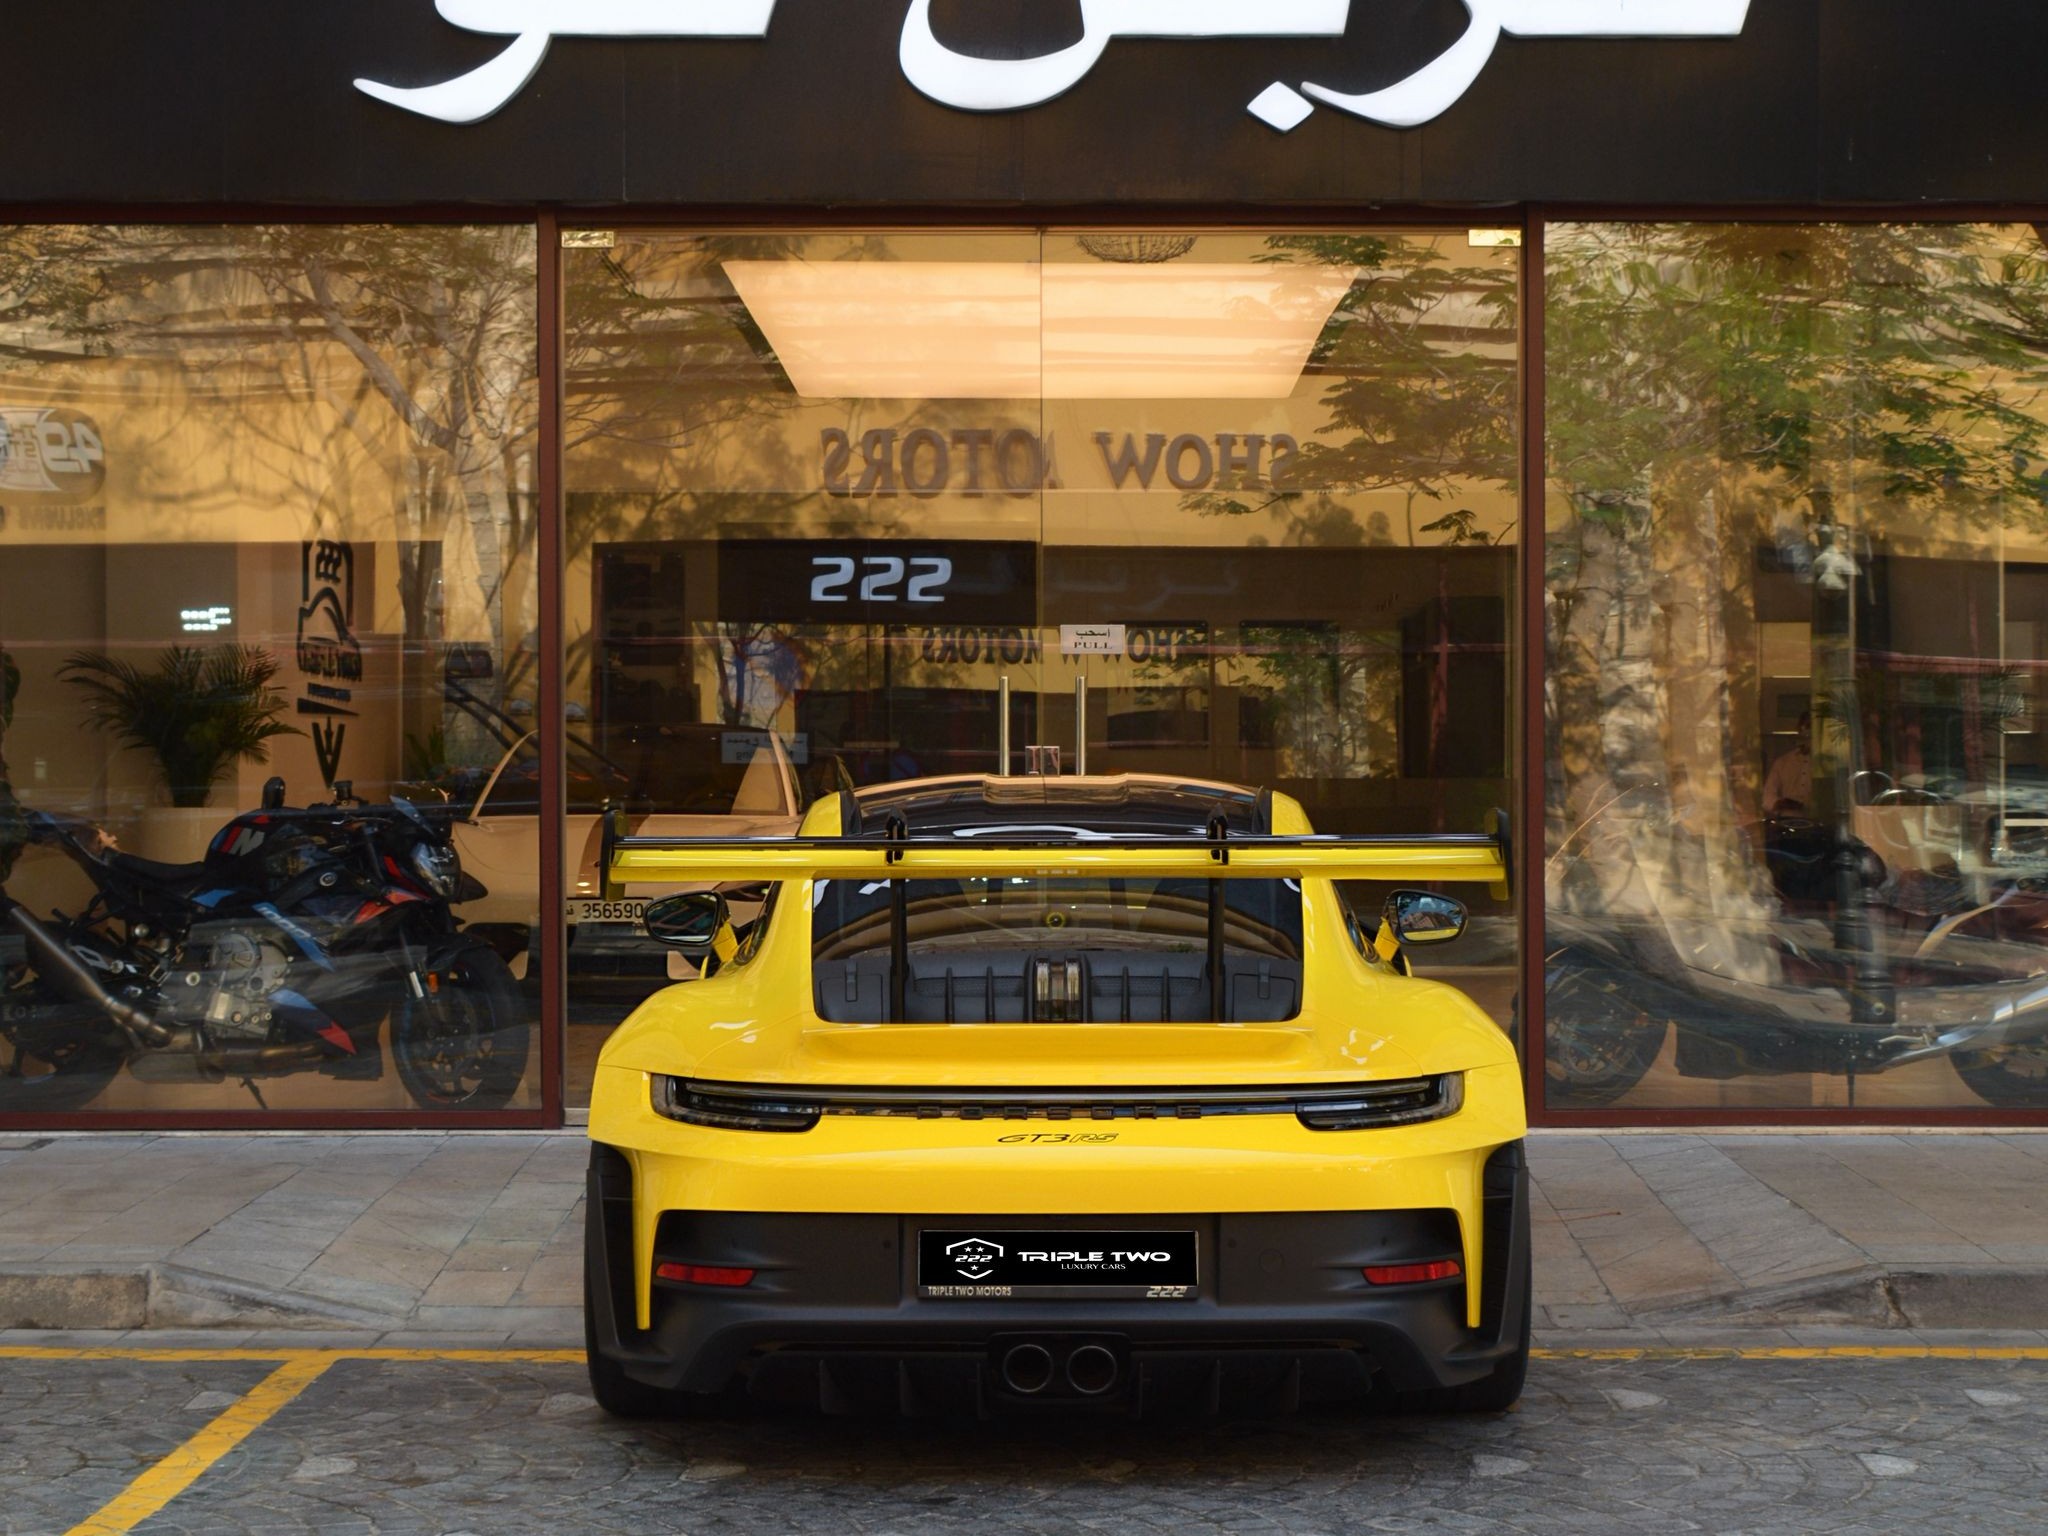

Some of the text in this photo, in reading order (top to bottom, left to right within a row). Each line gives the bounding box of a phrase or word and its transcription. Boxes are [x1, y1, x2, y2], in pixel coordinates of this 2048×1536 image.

[810, 556, 953, 603] 222
[1074, 641, 1113, 650] PULL
[581, 902, 645, 919] 356590
[954, 1253, 994, 1263] 222
[1017, 1251, 1172, 1263] TRIPLE TWO
[1061, 1263, 1127, 1271] LUXURY CARS
[928, 1286, 1012, 1297] TRIPLE TWO MOTORS
[1146, 1286, 1188, 1298] 222
